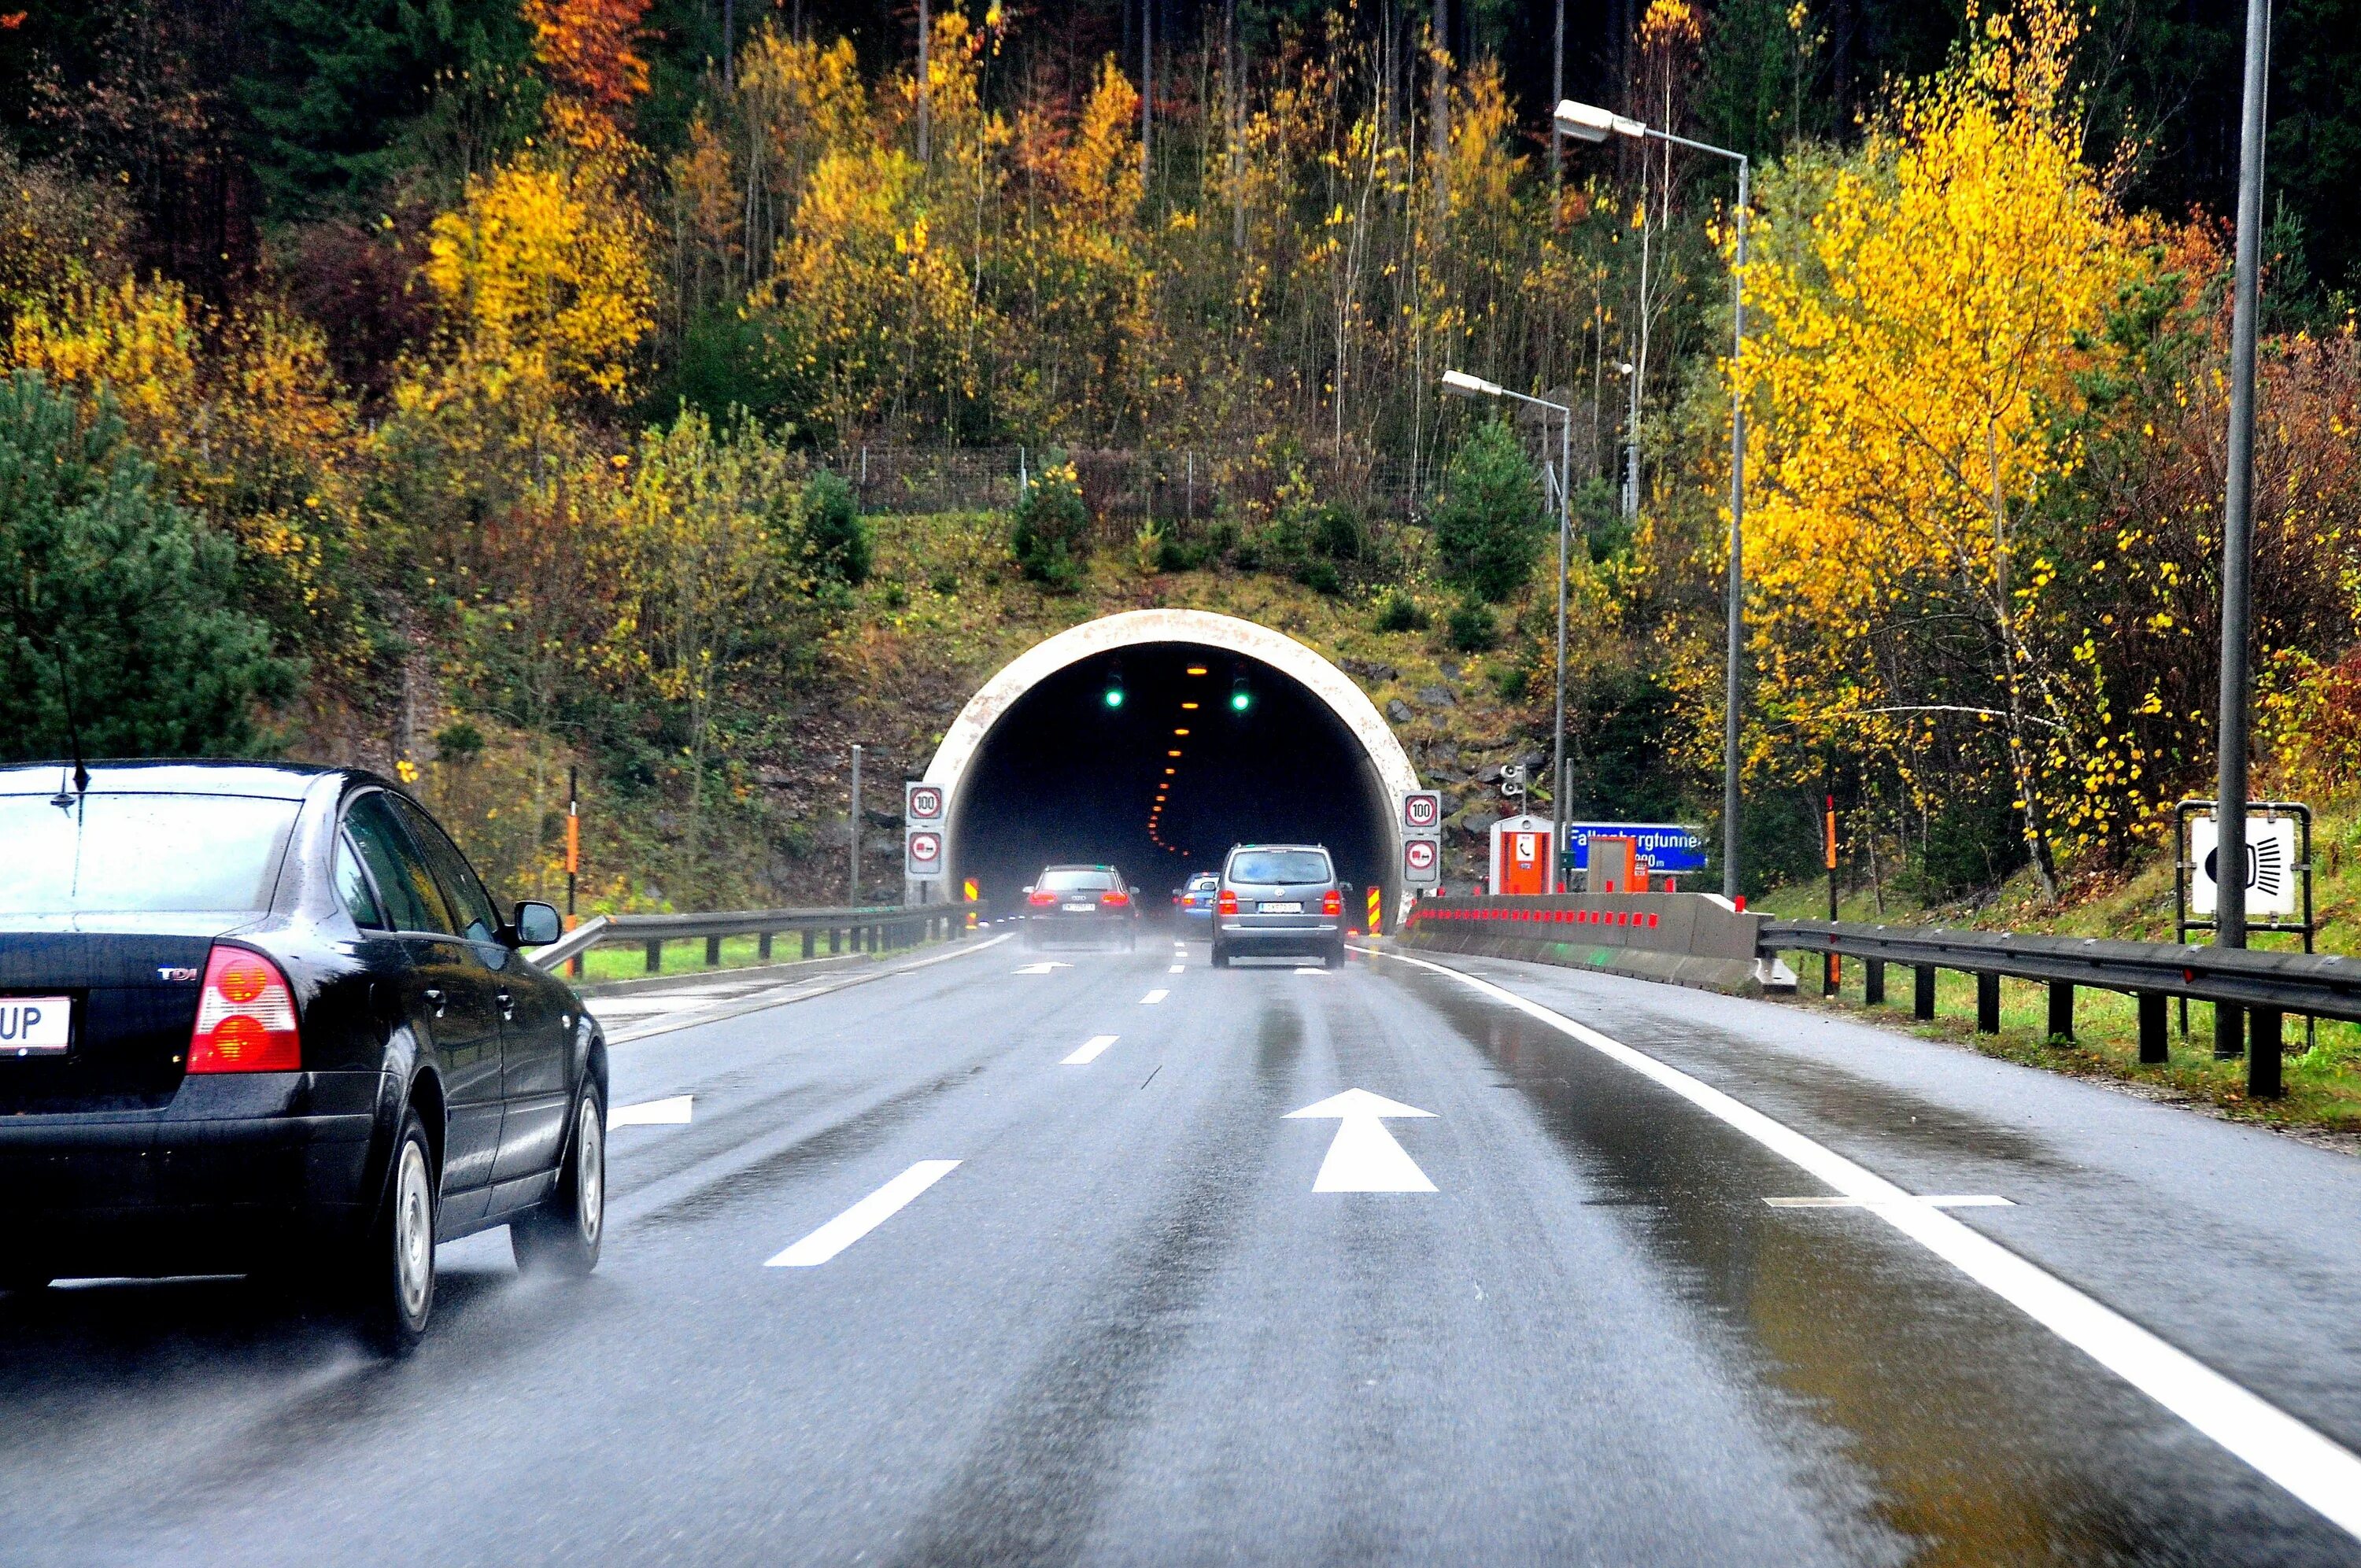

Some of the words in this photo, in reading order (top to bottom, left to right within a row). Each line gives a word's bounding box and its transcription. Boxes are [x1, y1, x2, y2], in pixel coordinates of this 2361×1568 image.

[917, 796, 934, 810] 100
[1413, 803, 1430, 817] 100
[157, 968, 197, 981] TDI
[0, 1007, 42, 1040] UP
